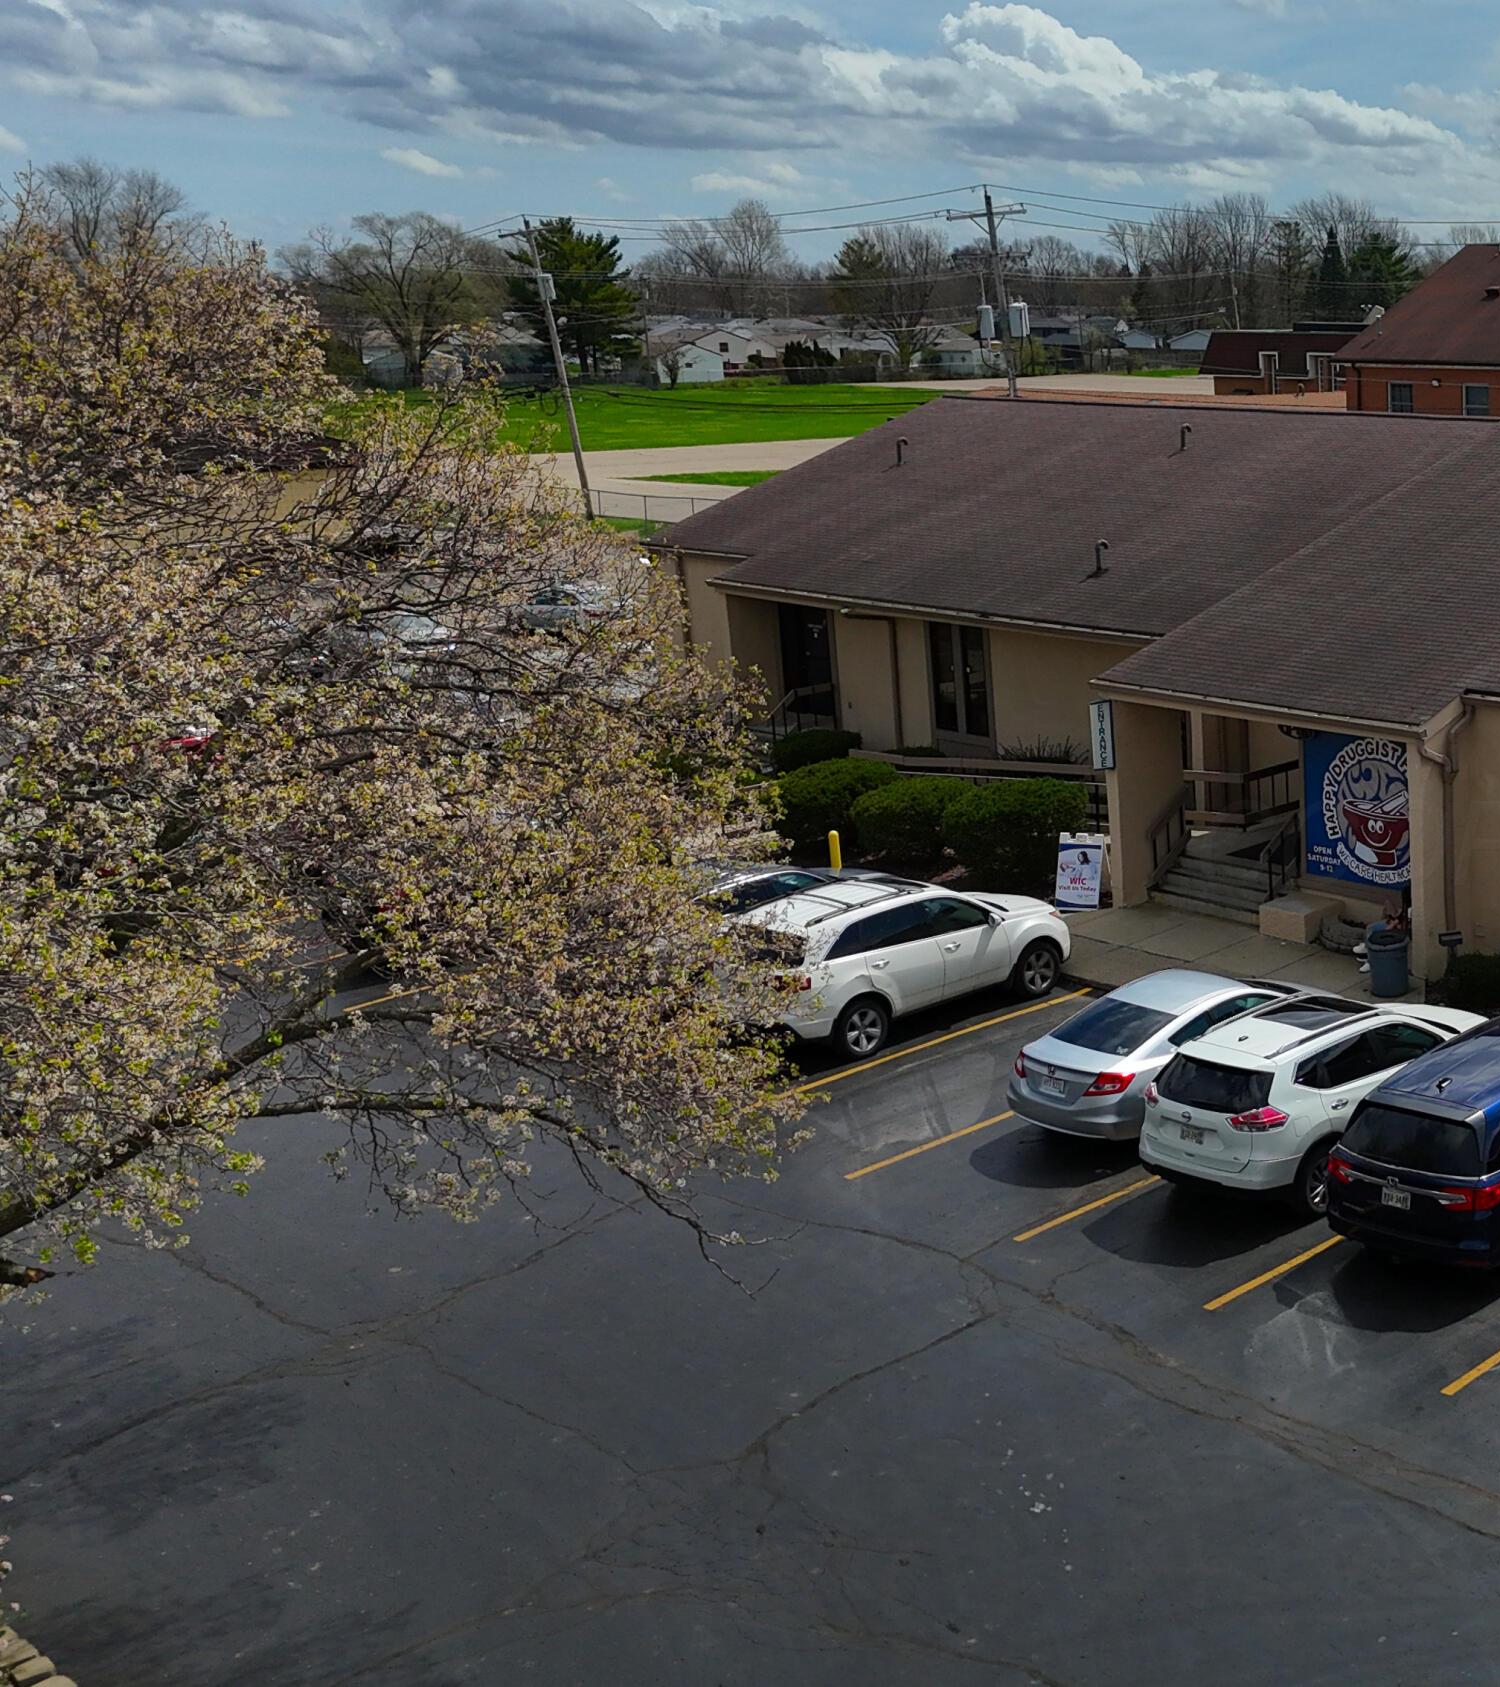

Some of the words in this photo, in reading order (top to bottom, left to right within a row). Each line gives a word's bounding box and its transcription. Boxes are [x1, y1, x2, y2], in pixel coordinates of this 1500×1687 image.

[1097, 703, 1108, 768] ENTRANCE
[1331, 740, 1399, 779] DRUGGIST
[1324, 774, 1340, 839] HAPPY
[1313, 845, 1332, 855] OPEN
[1307, 853, 1341, 866] SATURDAY
[1349, 859, 1372, 877] CARE
[1069, 877, 1087, 886] WIC
